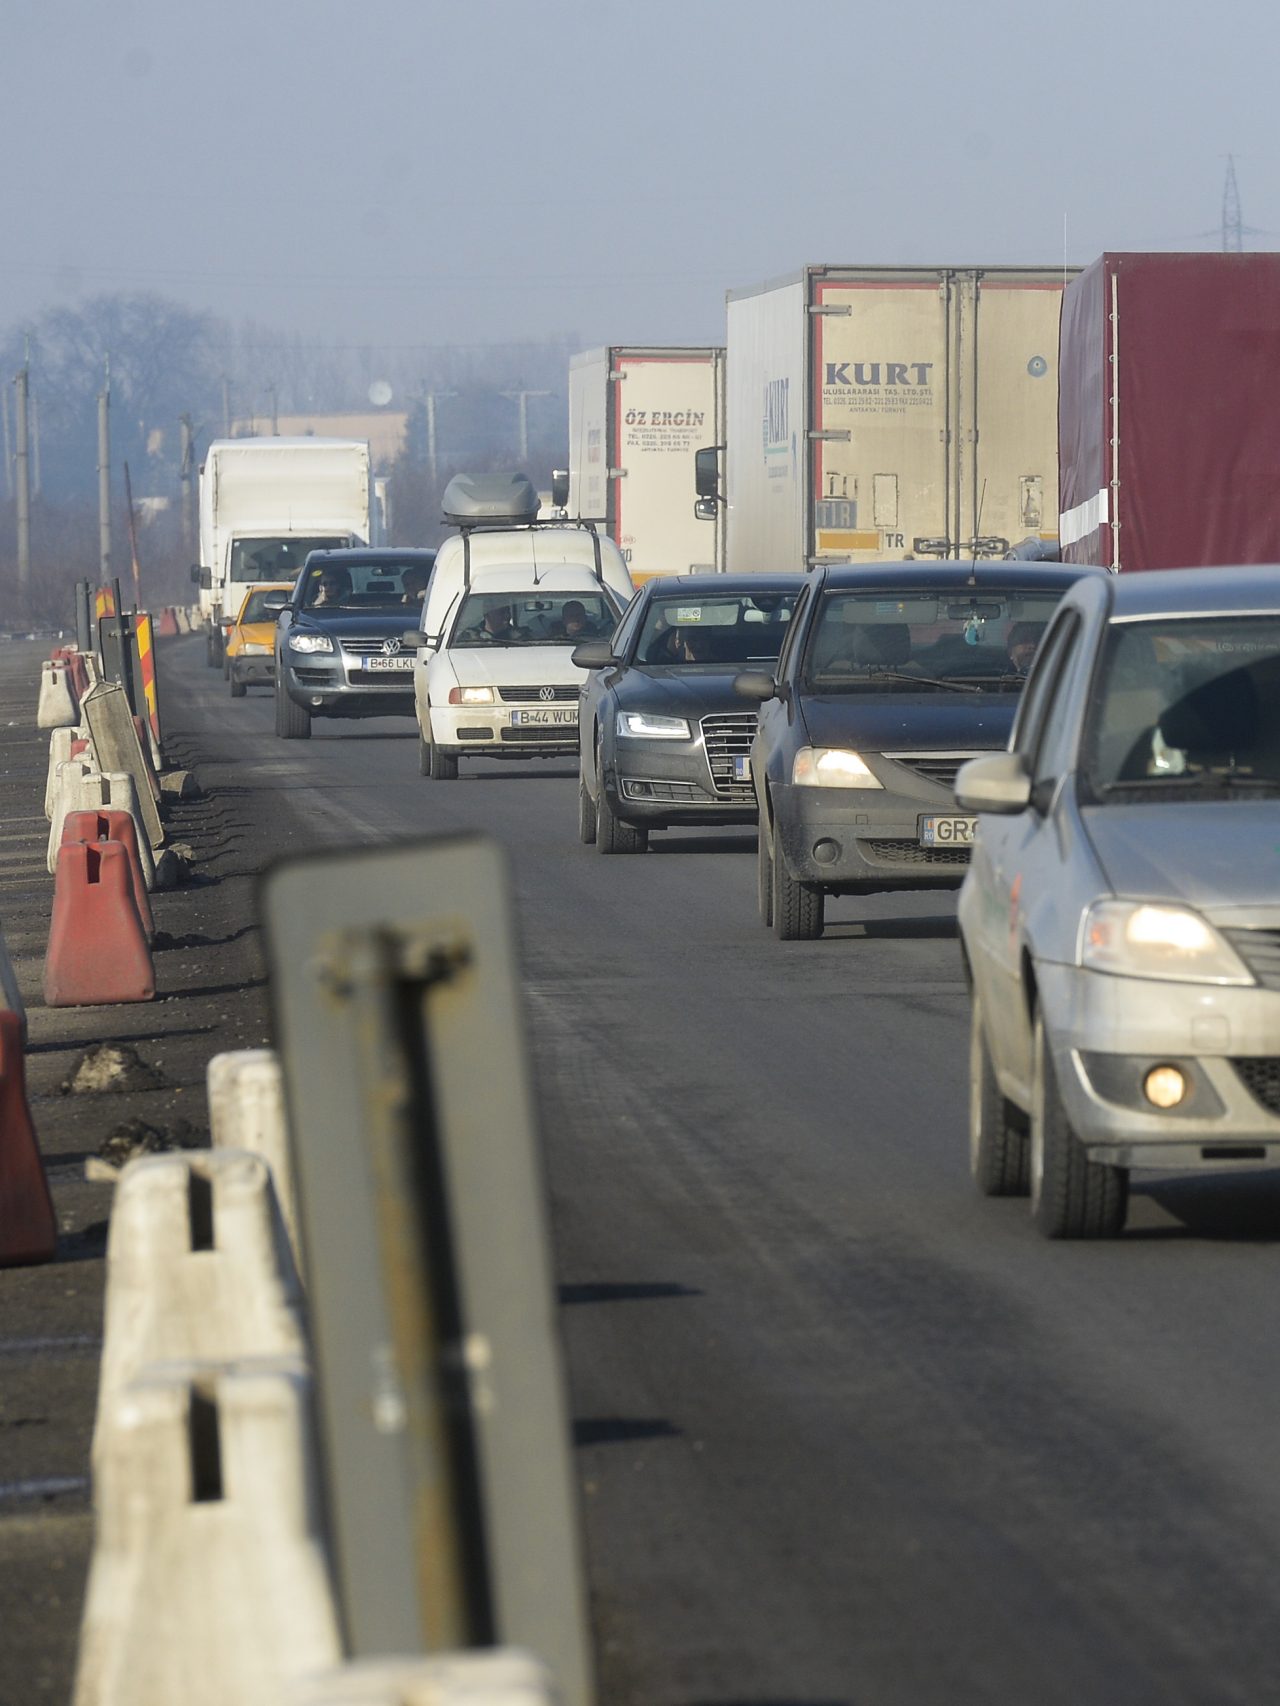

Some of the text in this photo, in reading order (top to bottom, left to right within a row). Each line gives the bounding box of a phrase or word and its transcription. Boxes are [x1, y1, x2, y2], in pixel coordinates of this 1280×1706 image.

[825, 362, 933, 386] KURT
[625, 408, 705, 426] ÖZ ERGİN
[819, 502, 850, 528] TIR
[885, 533, 904, 548] TR
[370, 658, 378, 668] B
[520, 711, 530, 724] B
[534, 711, 549, 723] 44
[924, 831, 934, 840] RO
[937, 820, 969, 841] GR
